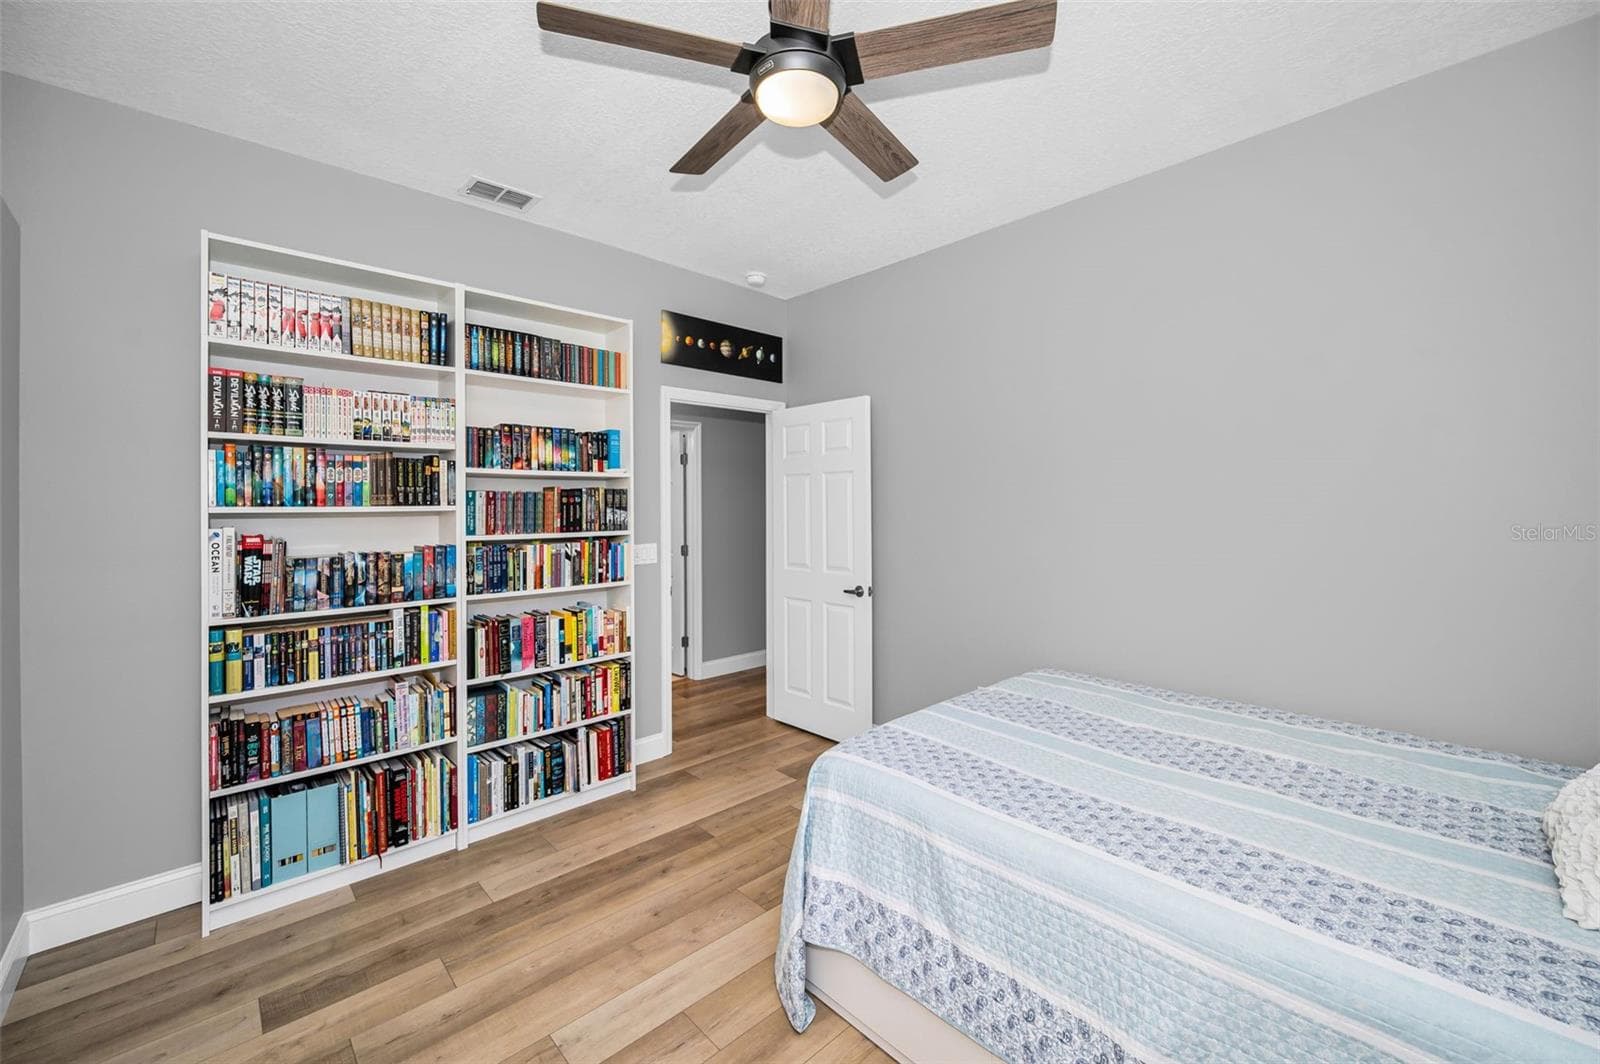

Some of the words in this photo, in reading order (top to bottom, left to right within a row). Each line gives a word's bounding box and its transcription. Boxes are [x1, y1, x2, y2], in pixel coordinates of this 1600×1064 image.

[213, 376, 223, 416] DEVILMAN
[230, 378, 241, 417] DEVILMAN
[211, 542, 220, 573] OCEAN
[244, 555, 253, 586] WARS
[252, 555, 262, 586] STAR
